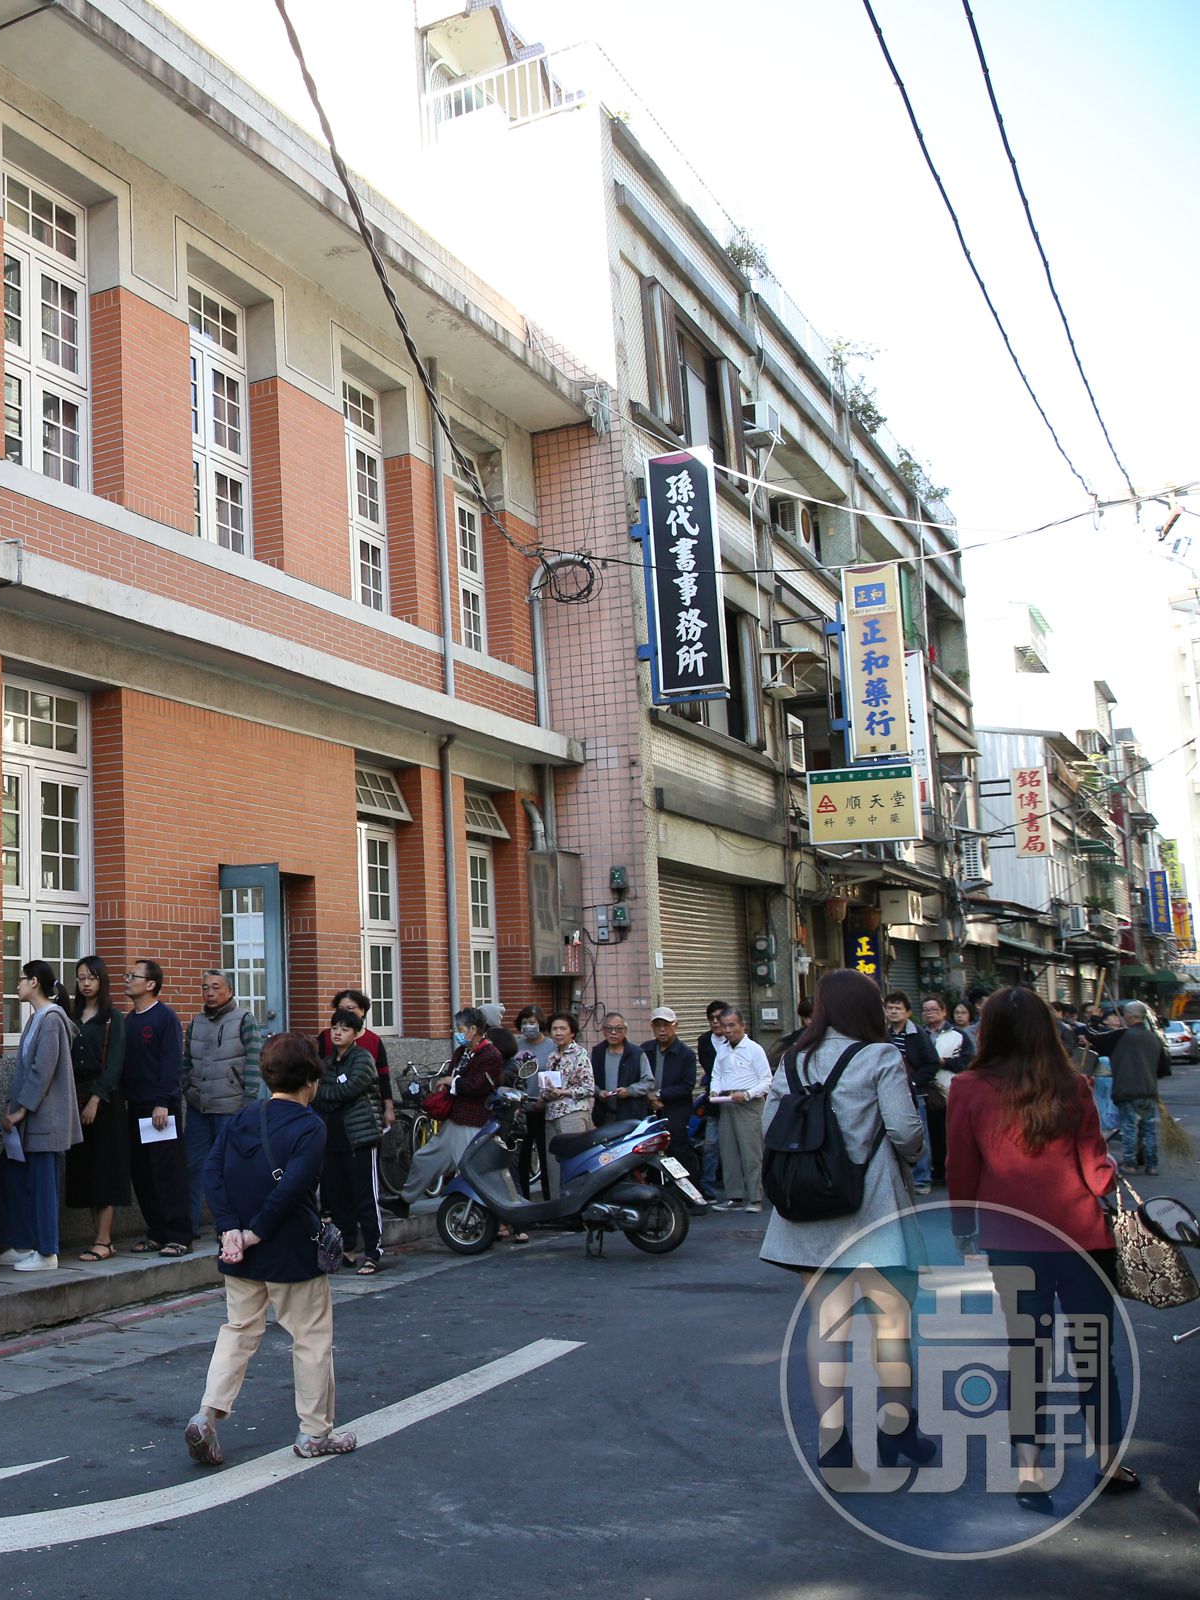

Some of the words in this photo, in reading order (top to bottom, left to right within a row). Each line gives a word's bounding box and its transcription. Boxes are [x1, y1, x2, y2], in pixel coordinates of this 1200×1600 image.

[665, 469, 708, 677] 孫代書事務所
[860, 618, 896, 737] 正和藥行
[845, 790, 906, 810] 順天堂
[1016, 770, 1046, 853] 銘傳書局
[855, 936, 877, 975] 正和
